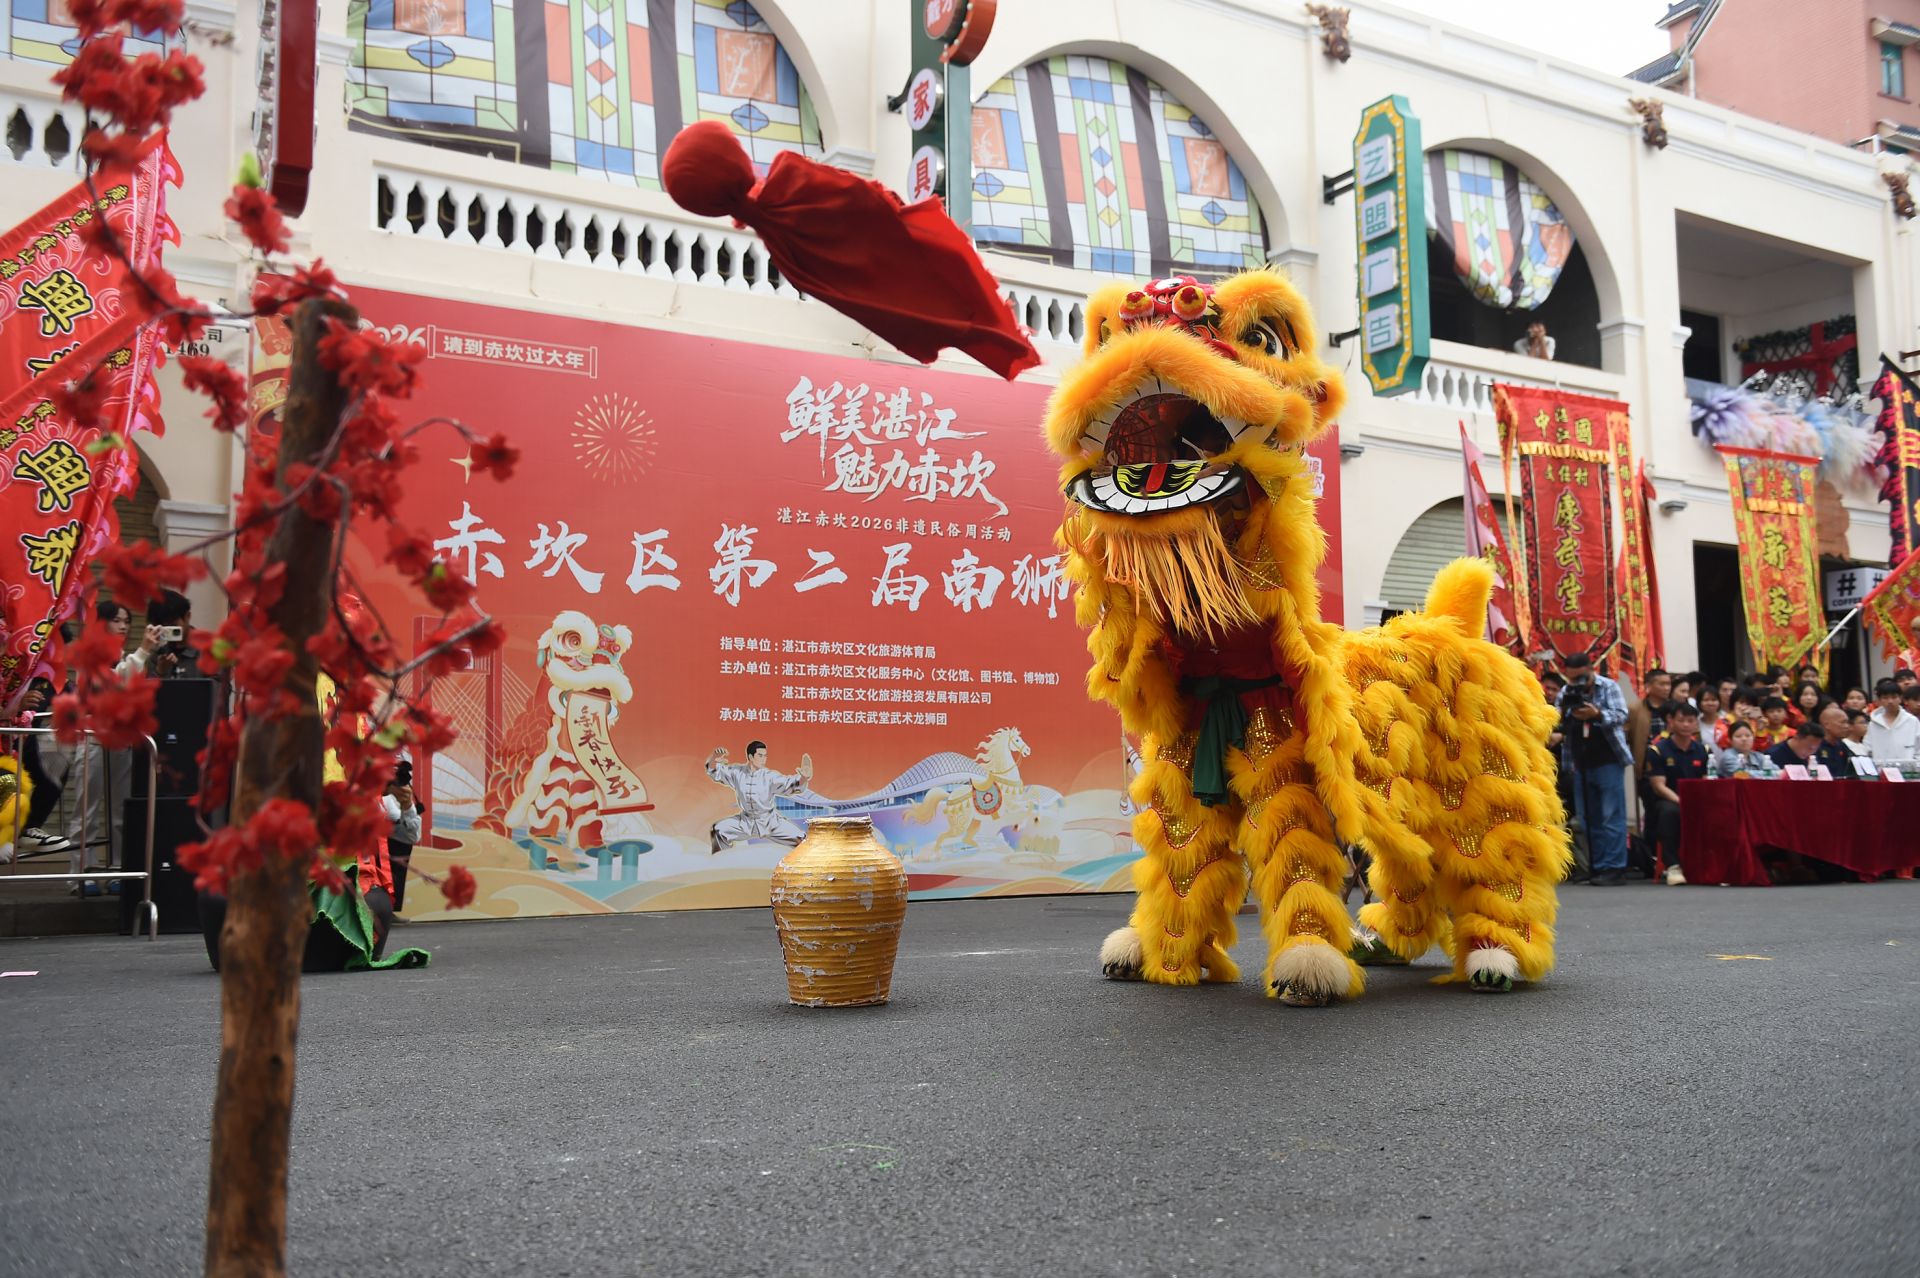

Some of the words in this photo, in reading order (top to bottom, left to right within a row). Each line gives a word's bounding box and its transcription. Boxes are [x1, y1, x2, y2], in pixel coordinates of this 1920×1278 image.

[913, 79, 932, 199] 家具
[1362, 145, 1392, 349] 艺盟广告
[443, 335, 585, 370] 请到赤坎过大年
[779, 375, 989, 480] 鲜美湛江
[823, 442, 1010, 523] 魅力赤坎
[776, 507, 1012, 543] 湛江赤坎2026非遗民俗周活动
[1553, 487, 1583, 613] 慶武堂
[719, 635, 936, 659] 指导单位：湛江市赤坎区文化旅游体育局
[719, 707, 948, 726] 承办单位：湛江市赤坎区庆武堂武术龙狮团
[781, 686, 992, 705] 湛江市赤坎区文化旅游投资发展有限公司
[573, 704, 641, 800] 新春快乐
